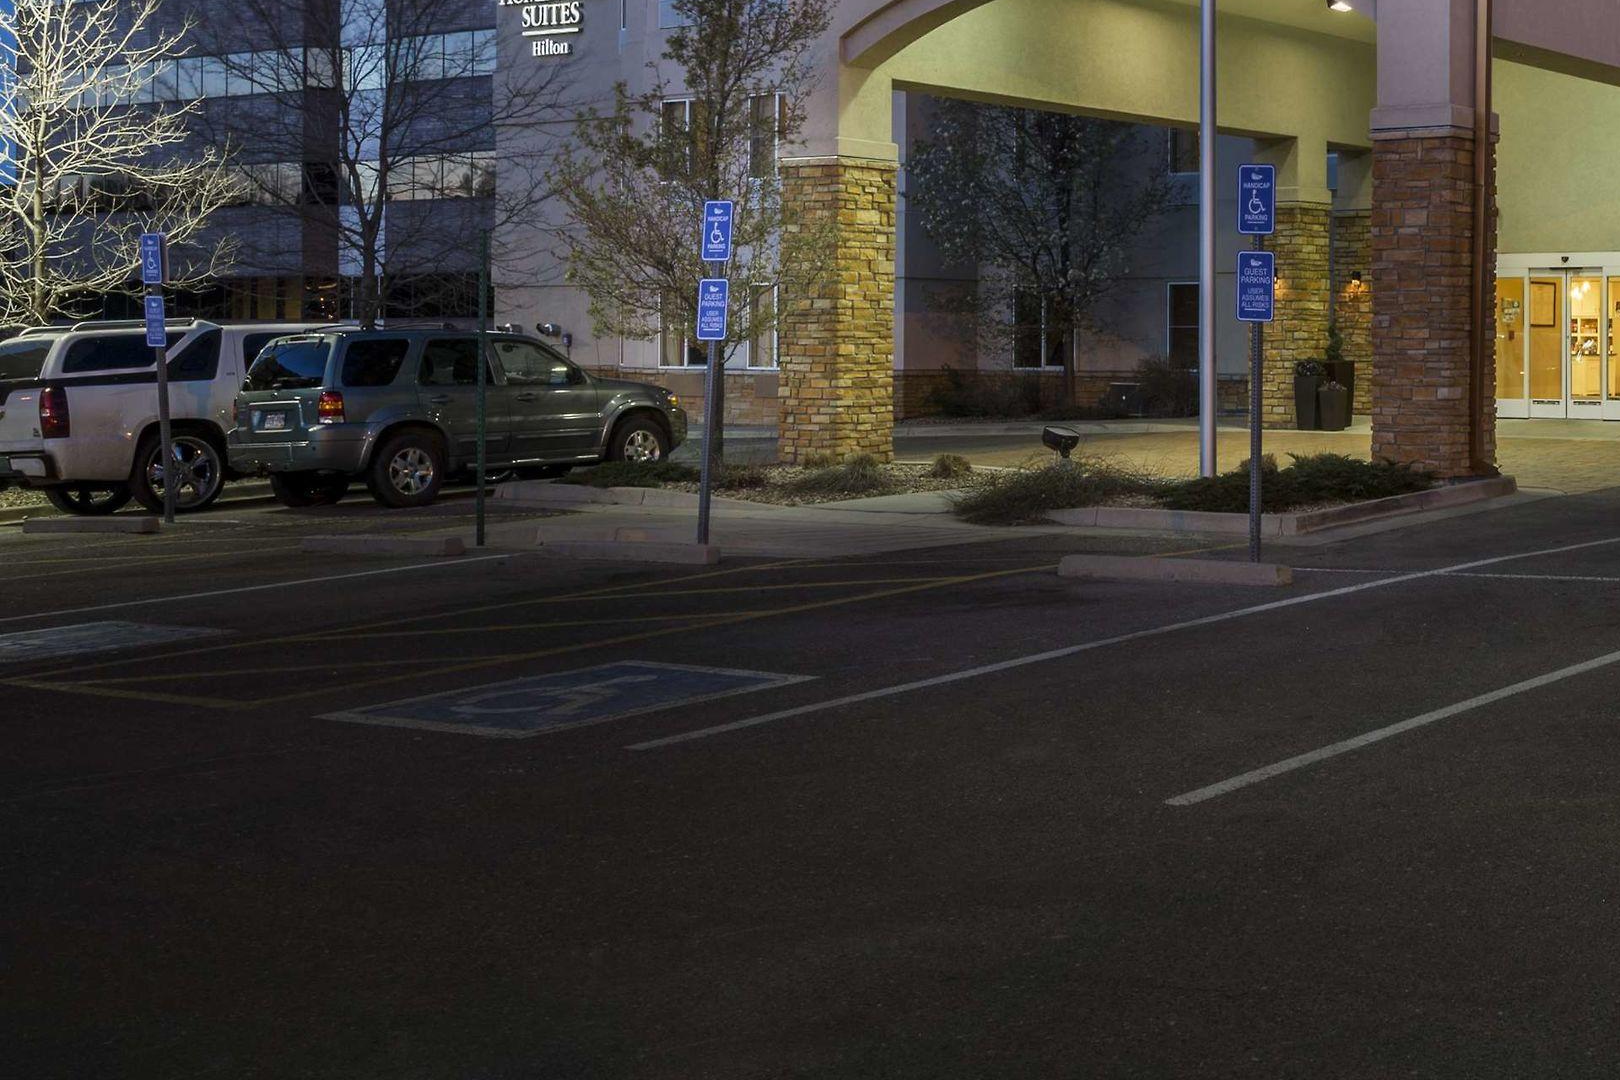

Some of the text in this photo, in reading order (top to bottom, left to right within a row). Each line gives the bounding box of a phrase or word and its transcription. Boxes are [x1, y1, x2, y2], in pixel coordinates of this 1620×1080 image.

[522, 2, 580, 27] SUITES
[532, 39, 569, 56] Hilton
[1244, 268, 1267, 276] GUEST
[1241, 276, 1271, 284] PARKING
